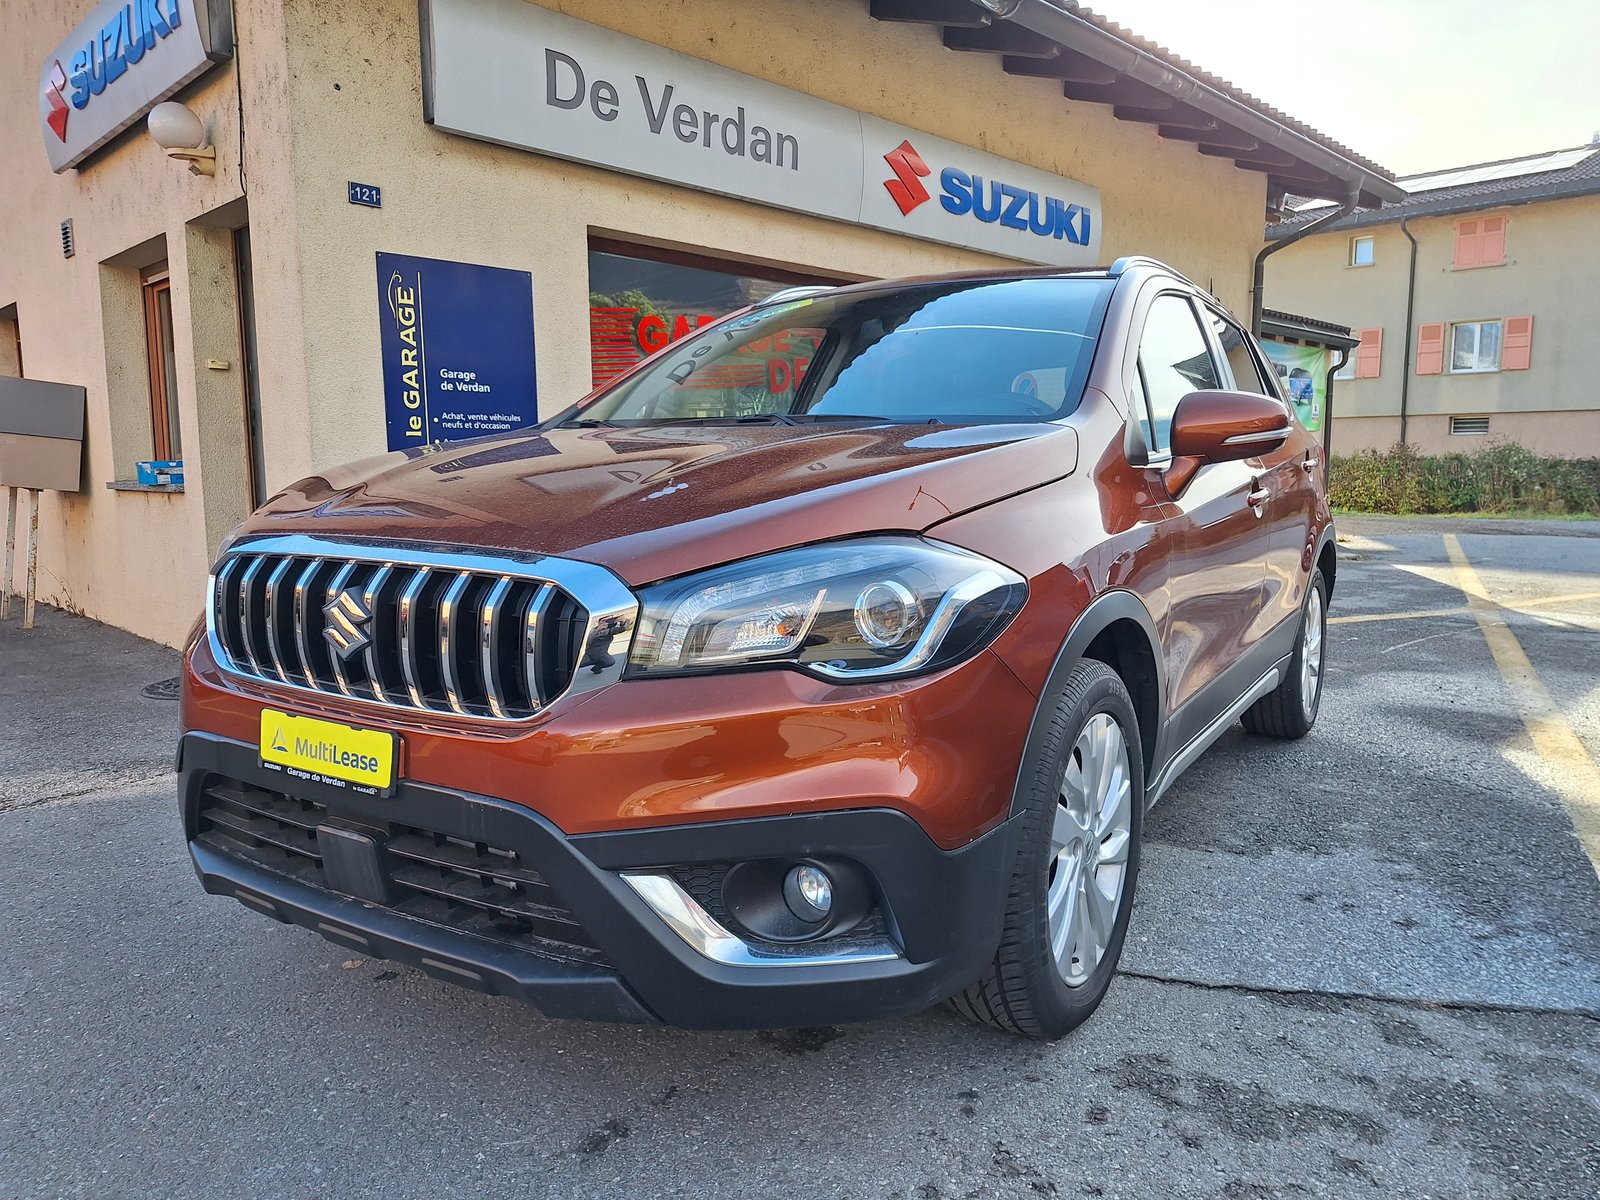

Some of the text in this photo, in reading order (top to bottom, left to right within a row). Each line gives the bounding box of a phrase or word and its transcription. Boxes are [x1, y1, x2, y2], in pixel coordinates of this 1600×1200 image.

[69, 0, 182, 110] SUZUKI
[544, 47, 800, 171] De Verdan
[355, 186, 377, 202] 121
[939, 166, 1091, 247] SUZUKI
[397, 286, 422, 437] le GARAGE
[440, 368, 476, 381] Garage
[441, 380, 490, 393] de Verdan
[442, 412, 520, 422] Achat, vente véhicules
[442, 421, 463, 429] neufs
[474, 421, 511, 430] d'occasion
[295, 736, 379, 773] MultiLease
[287, 767, 310, 780] Garage
[311, 773, 321, 782] de
[321, 775, 346, 788] Verdan
